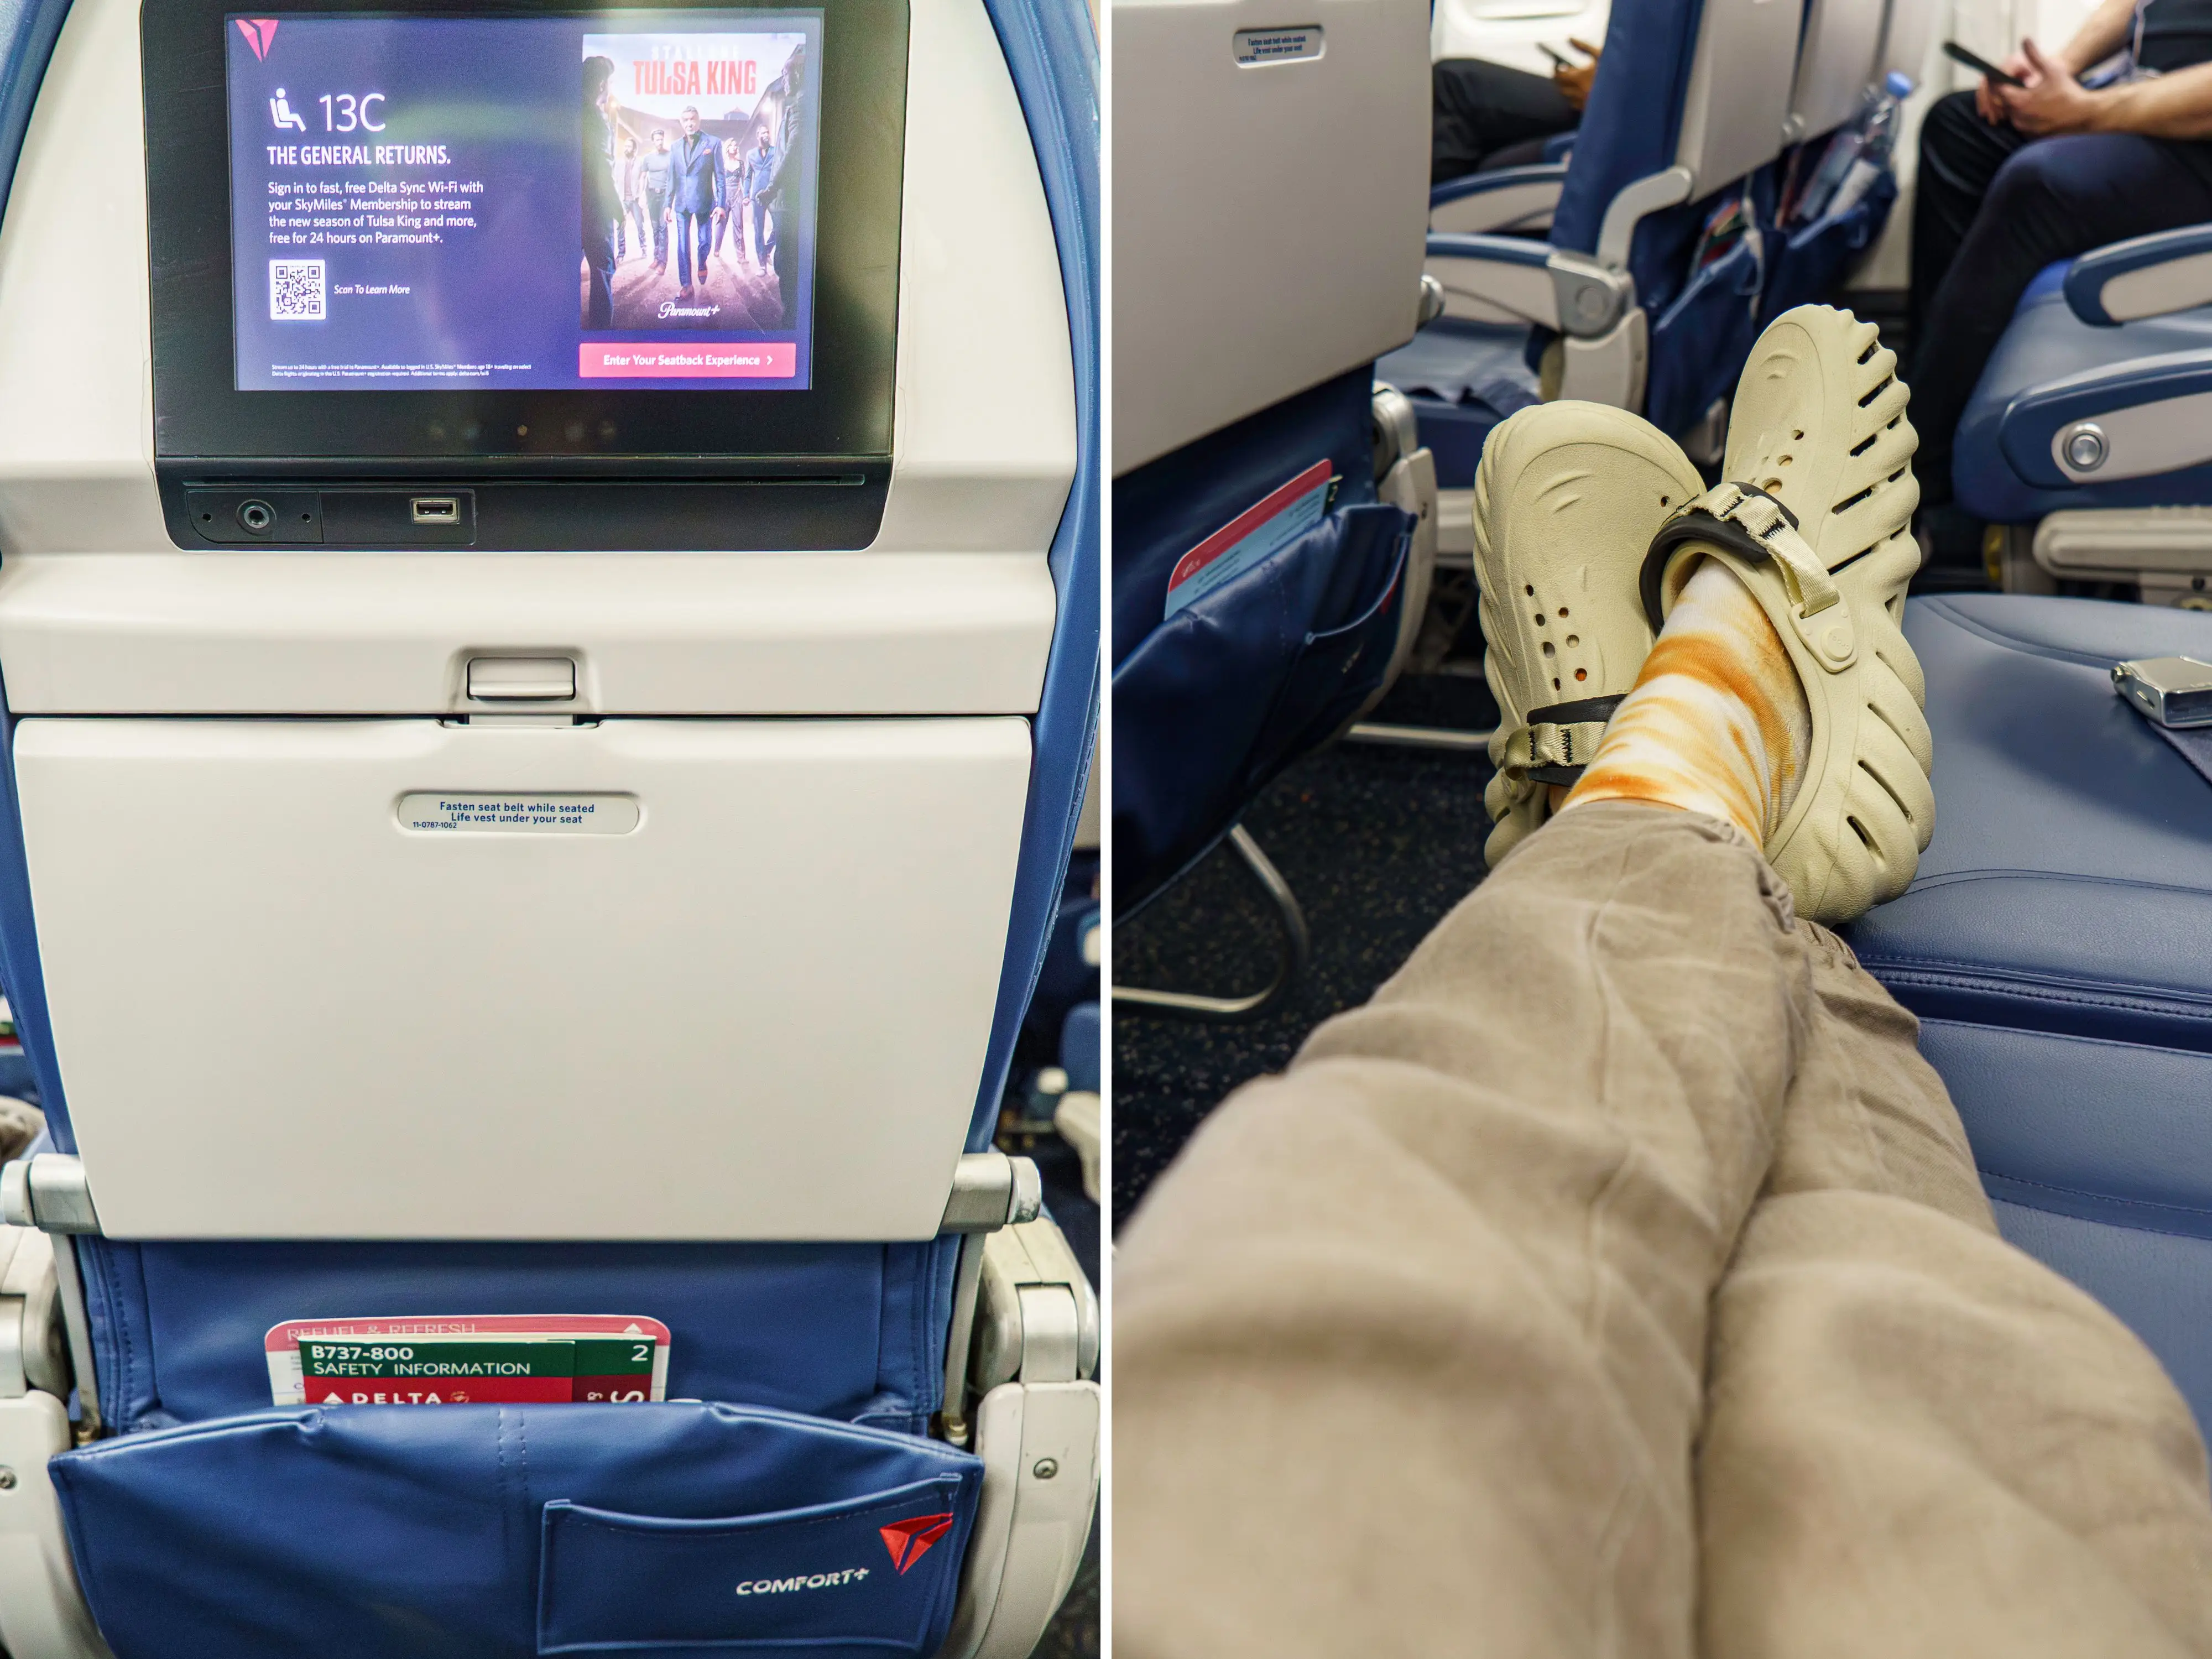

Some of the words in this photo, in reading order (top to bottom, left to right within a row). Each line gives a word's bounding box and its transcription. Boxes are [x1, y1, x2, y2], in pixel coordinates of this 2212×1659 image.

[633, 60, 701, 95] TULSA
[707, 60, 757, 95] KING
[319, 92, 387, 132] 13C
[267, 145, 298, 165] THE
[300, 145, 372, 165] GENERAL
[375, 145, 451, 165] RETURNS.
[268, 181, 291, 196] Sign
[294, 181, 304, 194] in
[306, 182, 317, 194] to
[320, 181, 342, 195] fast,
[345, 181, 366, 194] free
[368, 181, 397, 194] Delta
[400, 181, 426, 195] Sync
[427, 181, 457, 193] Wi-Fi
[460, 181, 483, 193] with
[268, 201, 292, 212] your
[350, 199, 418, 212] Membership
[420, 199, 431, 210] to
[434, 199, 471, 210] stream
[269, 215, 286, 227] the
[289, 218, 310, 227] new
[314, 218, 351, 227] season
[353, 215, 364, 227] of
[366, 215, 394, 227] Tulsa
[397, 215, 421, 229] King
[424, 215, 444, 227] and
[446, 217, 477, 228] more,
[269, 232, 290, 243] free
[293, 232, 307, 243] for
[310, 232, 324, 243] 24
[326, 231, 357, 243] hours
[359, 234, 373, 243] on
[375, 232, 443, 243] Paramount+.
[334, 285, 353, 295] Scan
[354, 285, 364, 295] To
[365, 285, 387, 295] Learn
[389, 285, 410, 295] More
[658, 301, 721, 319] Paramount+
[603, 354, 630, 366] Enter
[633, 354, 656, 366] Your
[658, 354, 703, 366] Seatback
[706, 354, 760, 367] Experience
[440, 802, 474, 812] Fasten
[478, 803, 500, 812] seat
[504, 802, 524, 812] belt
[528, 803, 556, 813] while
[559, 804, 595, 813] seated
[451, 812, 471, 822] Life
[474, 814, 495, 822] vest
[499, 813, 530, 823] under
[533, 816, 557, 825] your
[560, 815, 583, 823] seat
[312, 1345, 414, 1360] B737-800
[631, 1345, 648, 1361] 2
[314, 1363, 382, 1375] SAFETY
[394, 1363, 530, 1375] INFORMATION
[352, 1392, 442, 1404] DELTA
[735, 1567, 870, 1596] COMFORT+
